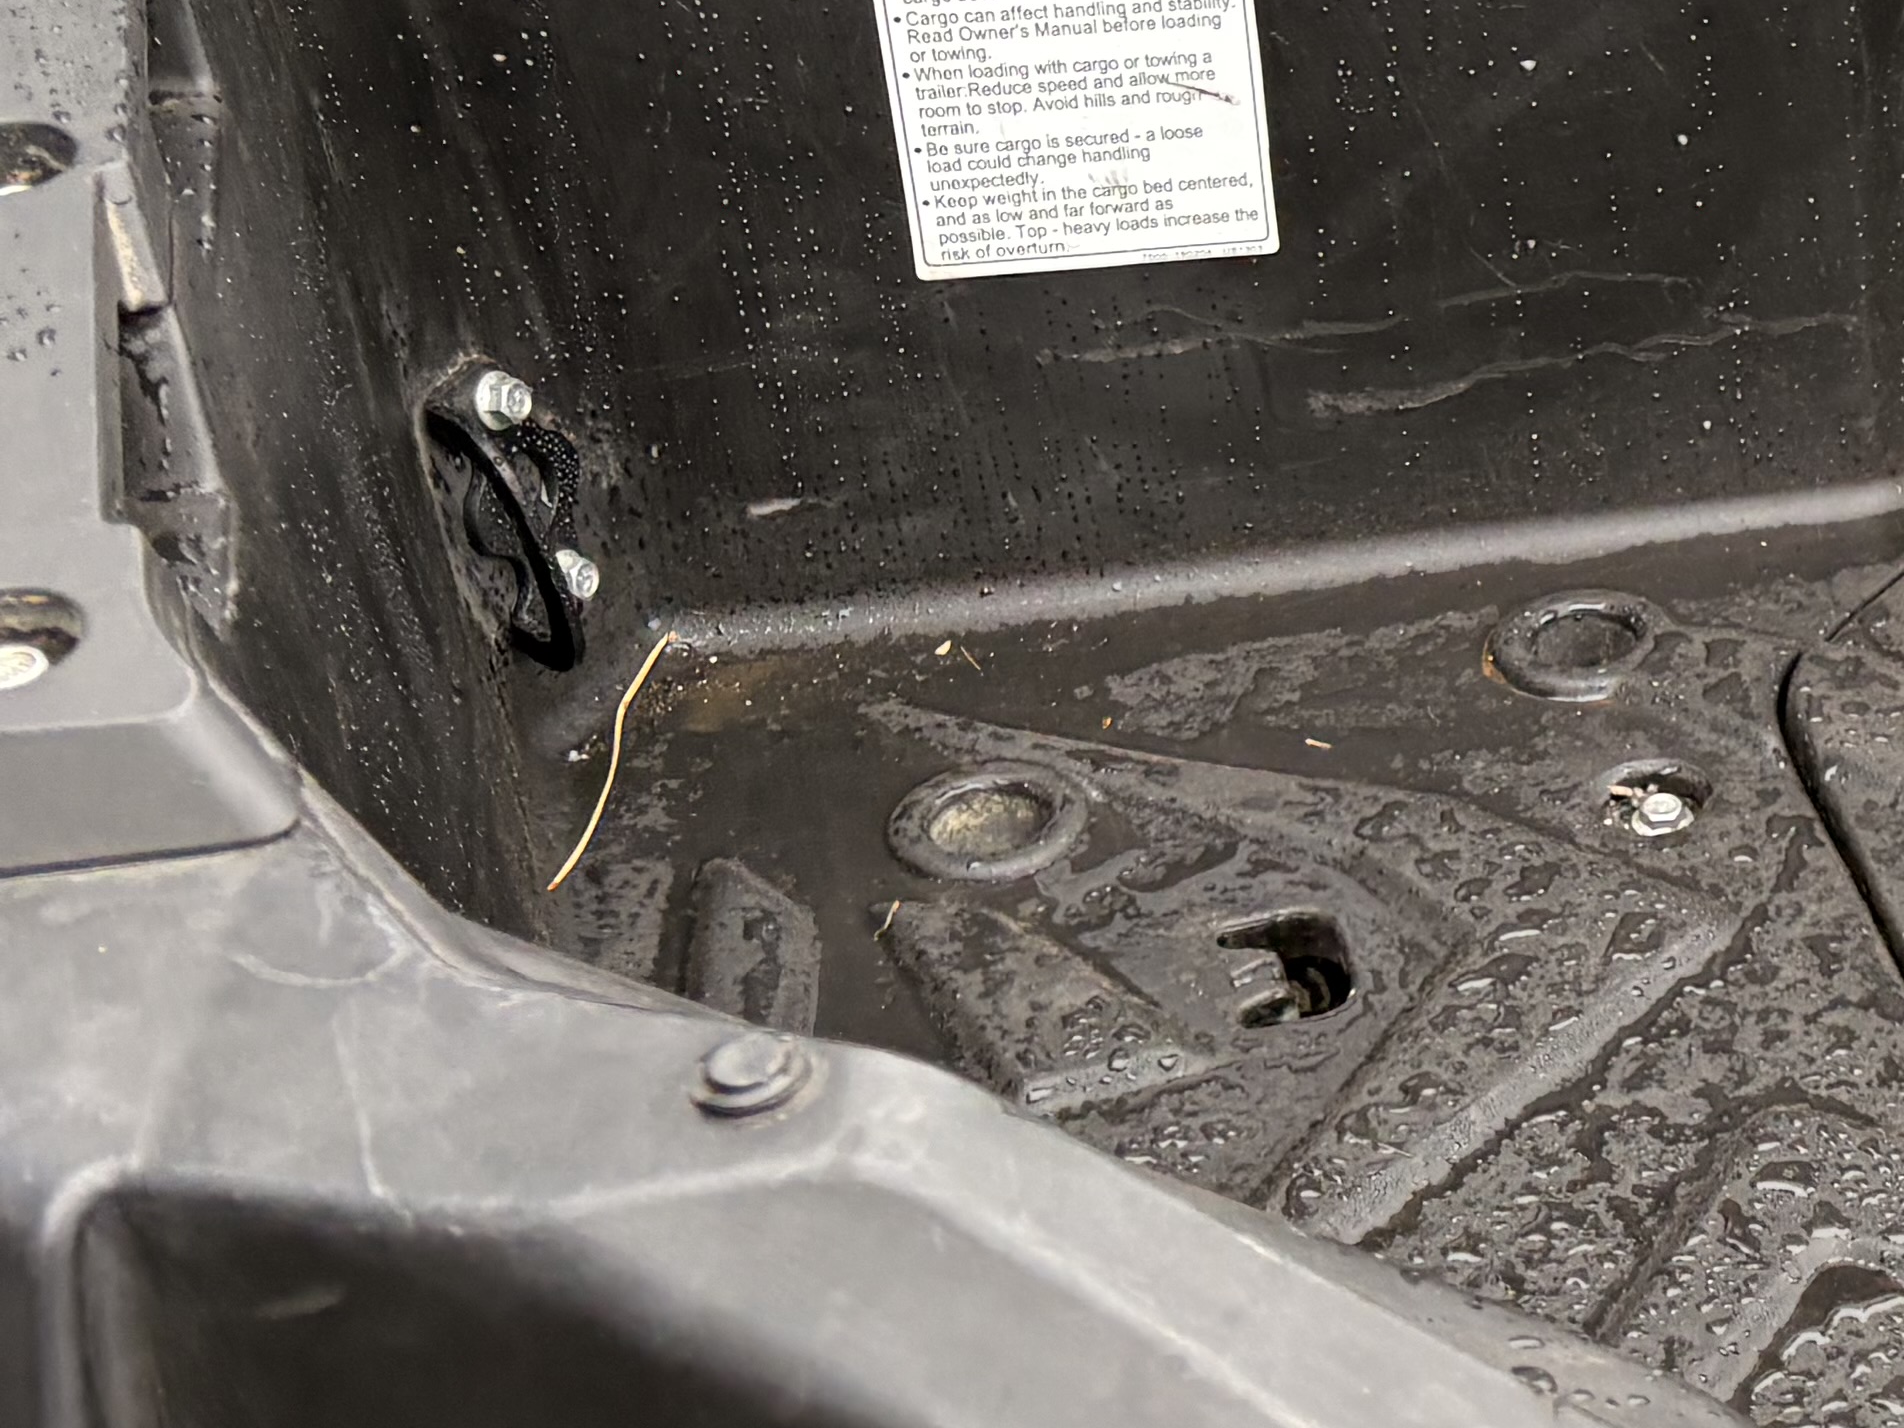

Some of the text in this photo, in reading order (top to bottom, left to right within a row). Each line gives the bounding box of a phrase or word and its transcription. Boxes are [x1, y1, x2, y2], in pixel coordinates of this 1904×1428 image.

[906, 11, 959, 29] Cargo
[964, 10, 995, 23] can
[1000, 5, 1048, 21] affect
[1054, 2, 1126, 19] handling
[1131, 0, 1163, 14] and
[908, 14, 1222, 44] Read Owner's Manual before loading
[910, 47, 992, 63] or towing.
[914, 52, 1212, 82] When loading with cargo or towing a
[1038, 78, 1087, 95] speed
[1093, 75, 1123, 89] and
[1129, 72, 1170, 87] allow
[1175, 70, 1216, 82] more
[919, 105, 961, 119] room
[966, 103, 982, 116] to
[988, 100, 1027, 118] stop.
[1033, 95, 1078, 112] Avoid
[1084, 93, 1116, 108] hills
[1121, 91, 1151, 105] and
[922, 121, 979, 138] terrain.
[927, 143, 948, 157] Be
[955, 140, 990, 154] sure
[996, 138, 1041, 154] cargo
[1046, 135, 1060, 148] is
[1065, 129, 1129, 147] secured
[1146, 129, 1155, 142] a
[1161, 125, 1203, 140] loose
[927, 146, 1150, 173] load could change handling
[930, 173, 1044, 192] unexpectedly.
[934, 194, 978, 210] Keep
[983, 189, 1038, 206] weight
[1043, 188, 1056, 202] in
[1061, 185, 1086, 199] the
[1093, 184, 1138, 199] cargo
[1143, 180, 1173, 193] bed
[936, 198, 1173, 226] and as low and far forward as
[939, 228, 1010, 246] possible.
[1016, 223, 1047, 239] Top
[1063, 219, 1110, 237] heavy
[1116, 215, 1158, 230] loads
[1163, 210, 1230, 227] increase
[1235, 207, 1258, 221] the
[941, 247, 970, 261] risk
[976, 245, 991, 258] of
